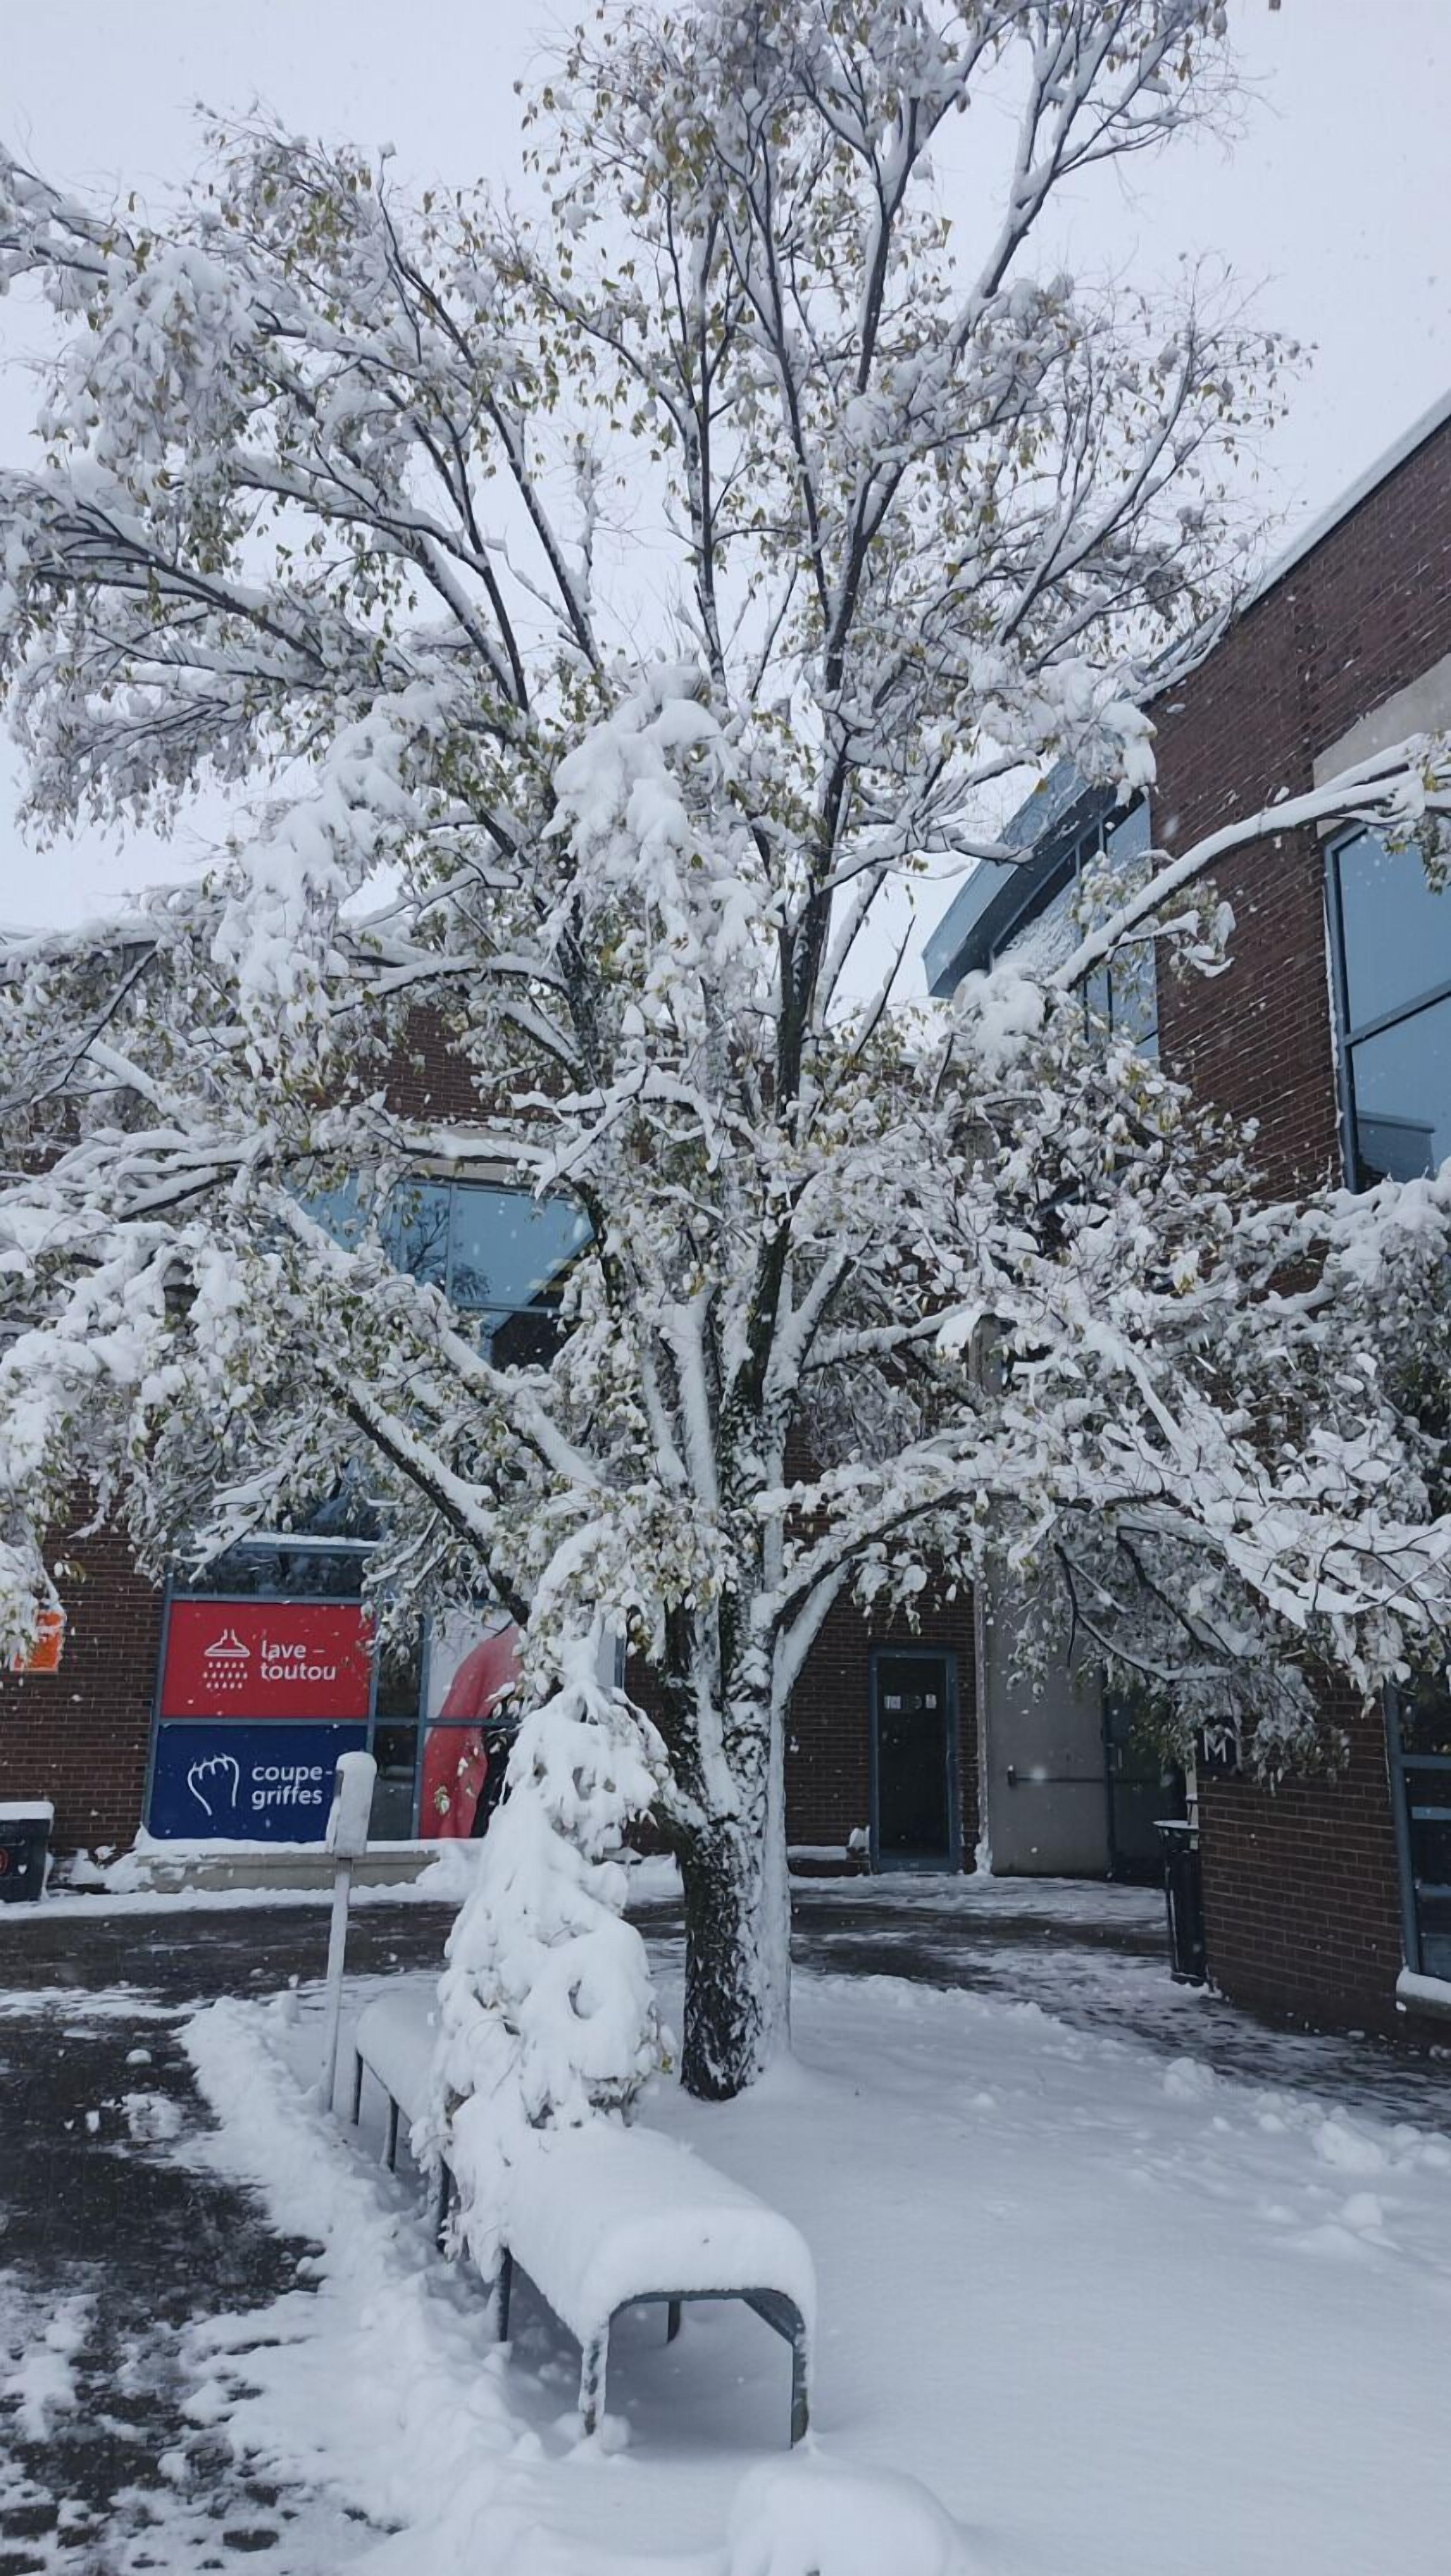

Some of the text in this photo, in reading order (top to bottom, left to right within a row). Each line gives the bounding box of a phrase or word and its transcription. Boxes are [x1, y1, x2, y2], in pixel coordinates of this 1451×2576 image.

[260, 1662, 336, 1680] toutou
[252, 1766, 333, 1787] coupe-
[252, 1785, 322, 1810] griffes
